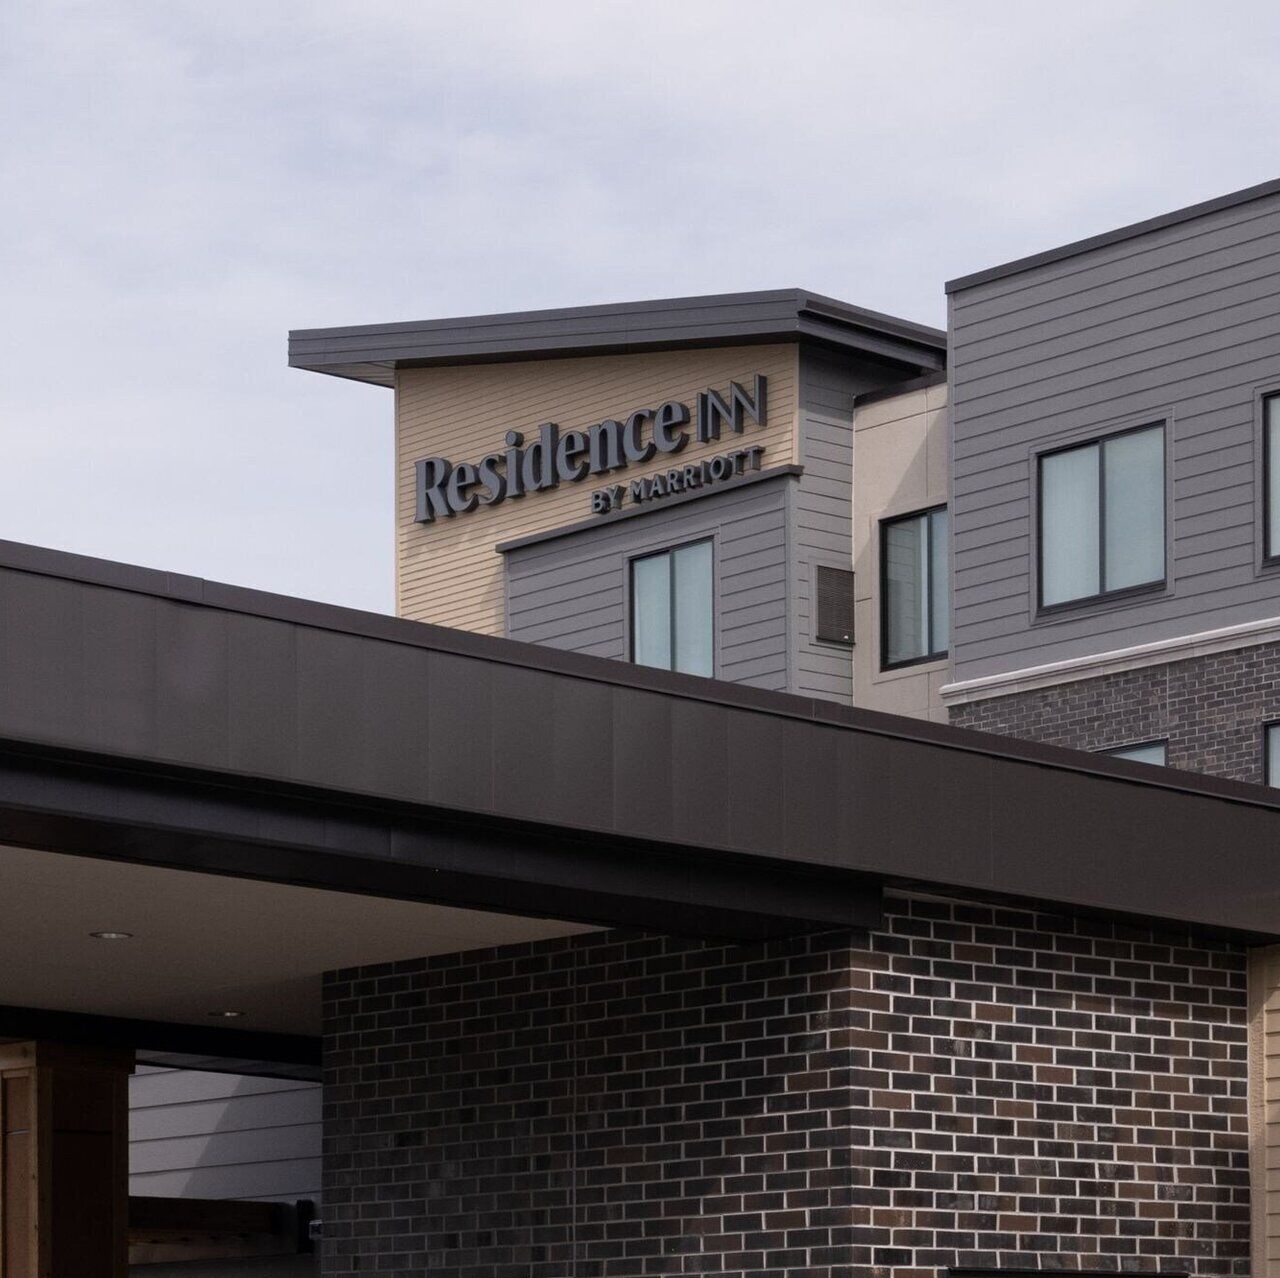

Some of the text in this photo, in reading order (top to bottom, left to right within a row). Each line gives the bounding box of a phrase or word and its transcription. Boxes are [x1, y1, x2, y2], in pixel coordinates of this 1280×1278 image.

[414, 374, 768, 523] Residence INN
[591, 445, 766, 514] BY MARRIOTT
